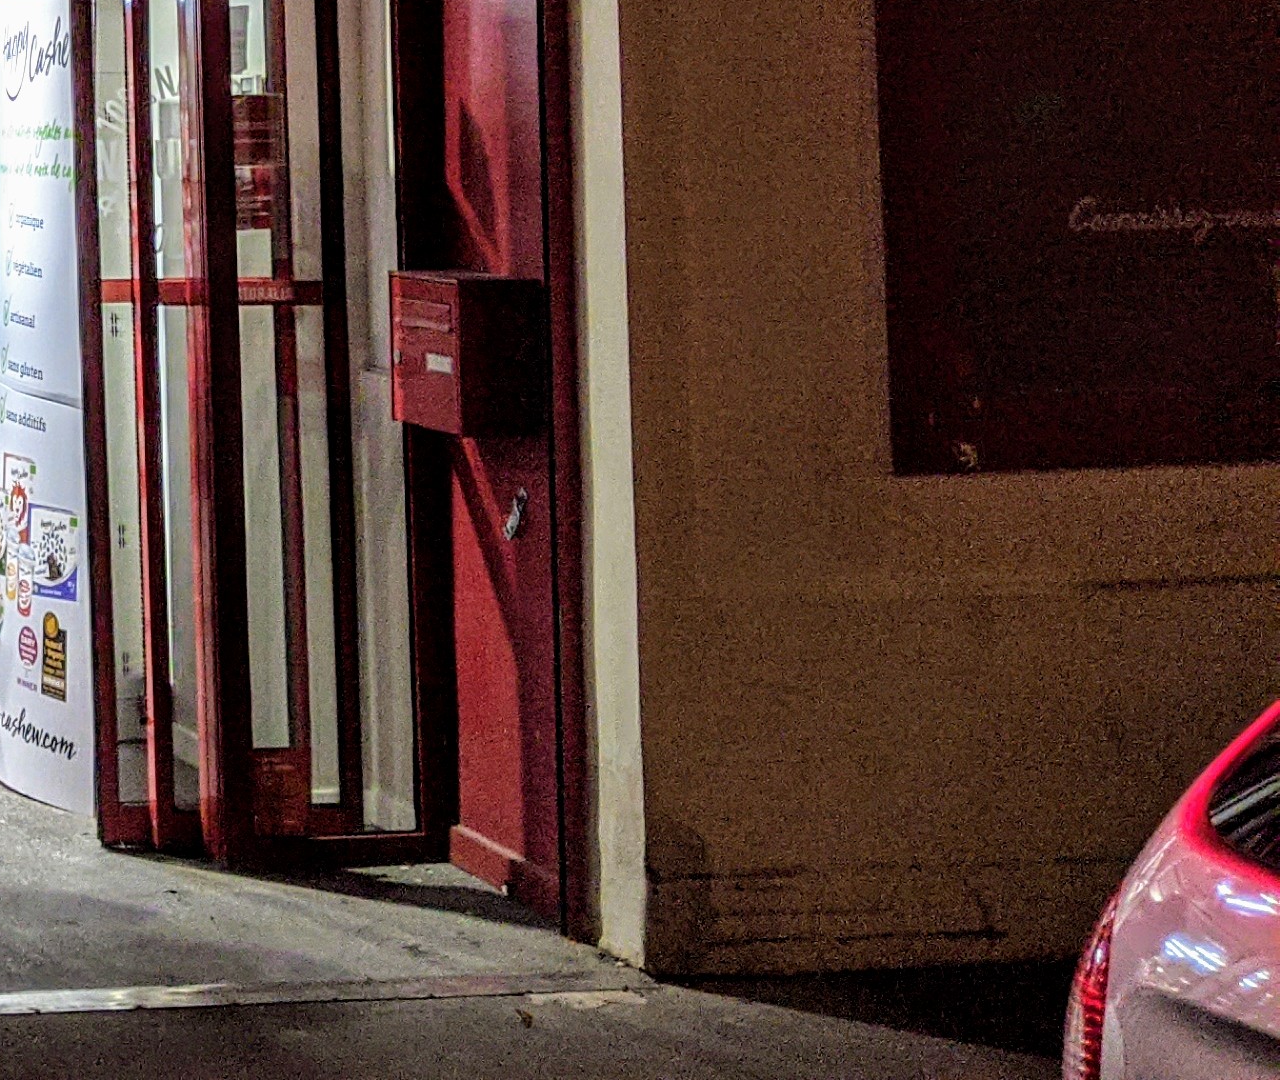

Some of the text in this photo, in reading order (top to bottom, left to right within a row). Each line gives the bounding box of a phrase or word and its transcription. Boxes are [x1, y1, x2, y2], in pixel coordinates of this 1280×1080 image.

[28, 15, 71, 83] Cashe
[19, 361, 44, 381] gluten
[18, 412, 47, 433] additifs
